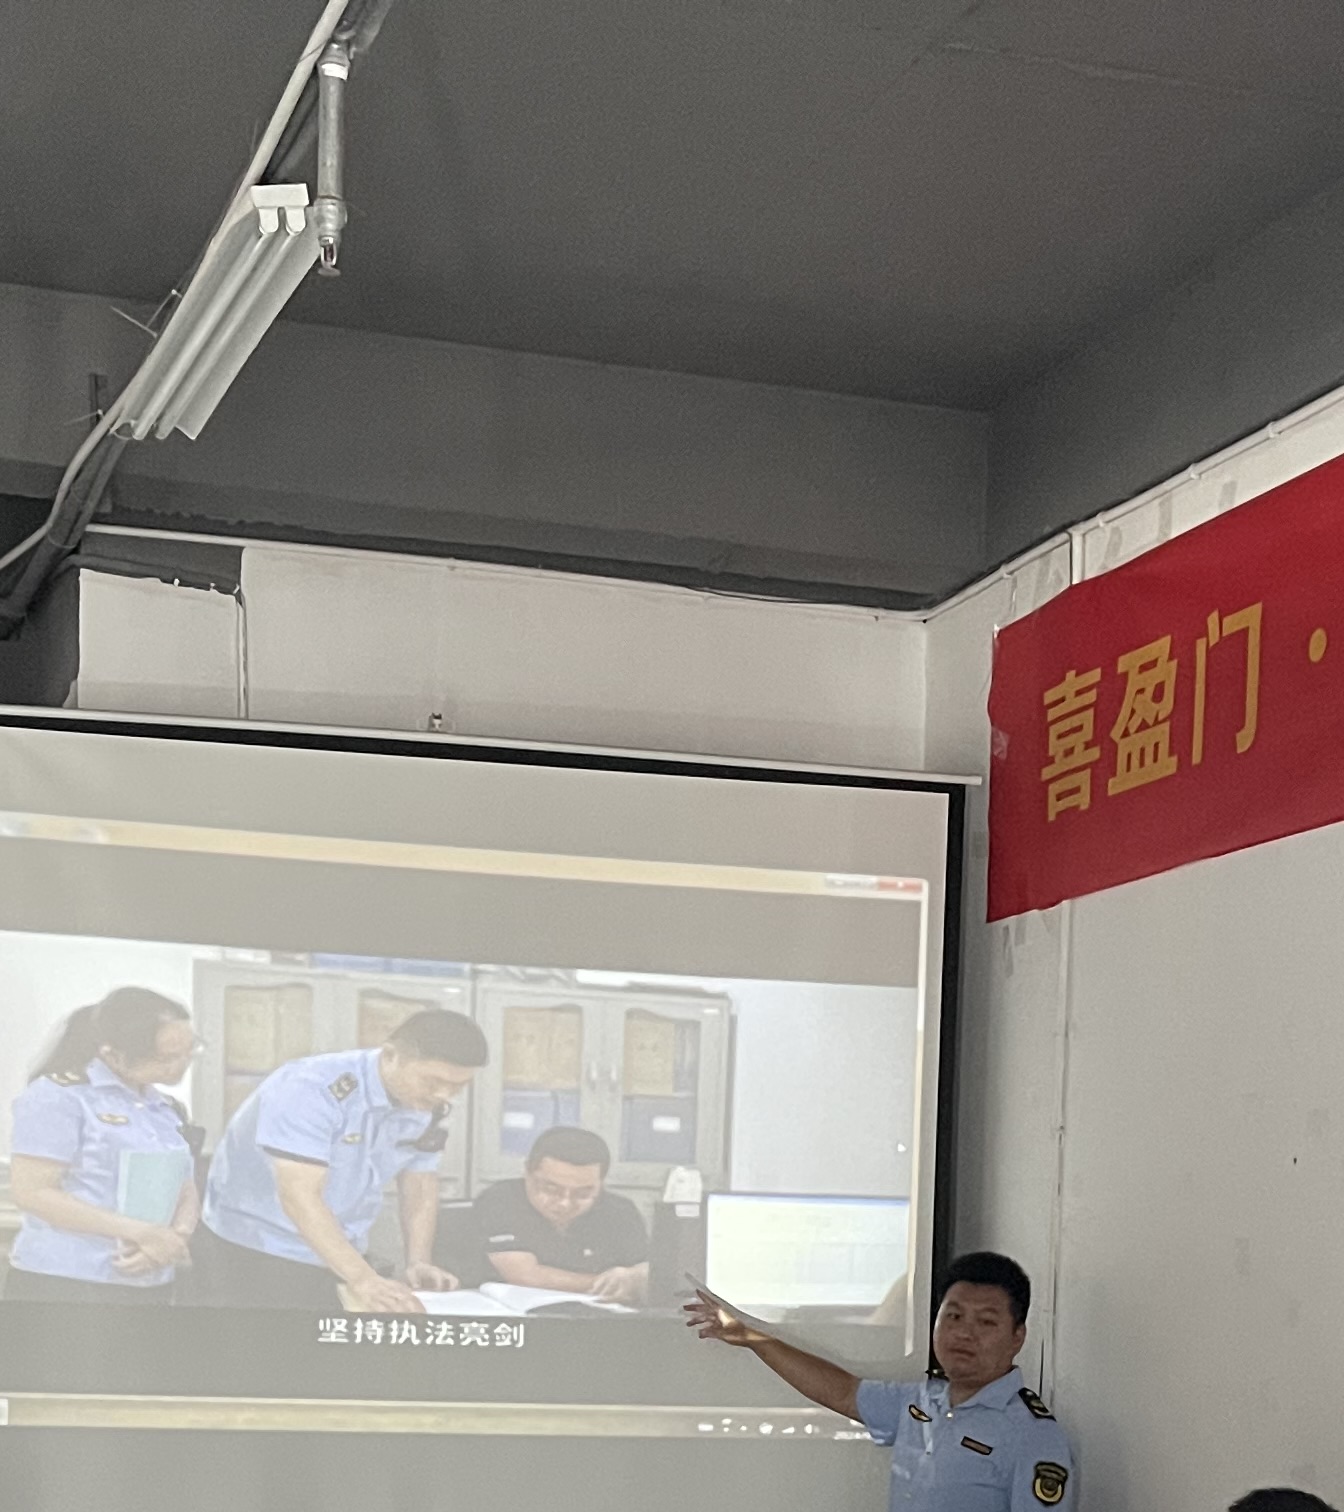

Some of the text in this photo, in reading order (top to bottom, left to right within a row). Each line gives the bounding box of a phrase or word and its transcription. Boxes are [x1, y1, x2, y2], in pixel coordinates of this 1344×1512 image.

[317, 1318, 525, 1347] 坚持执法亮剑
